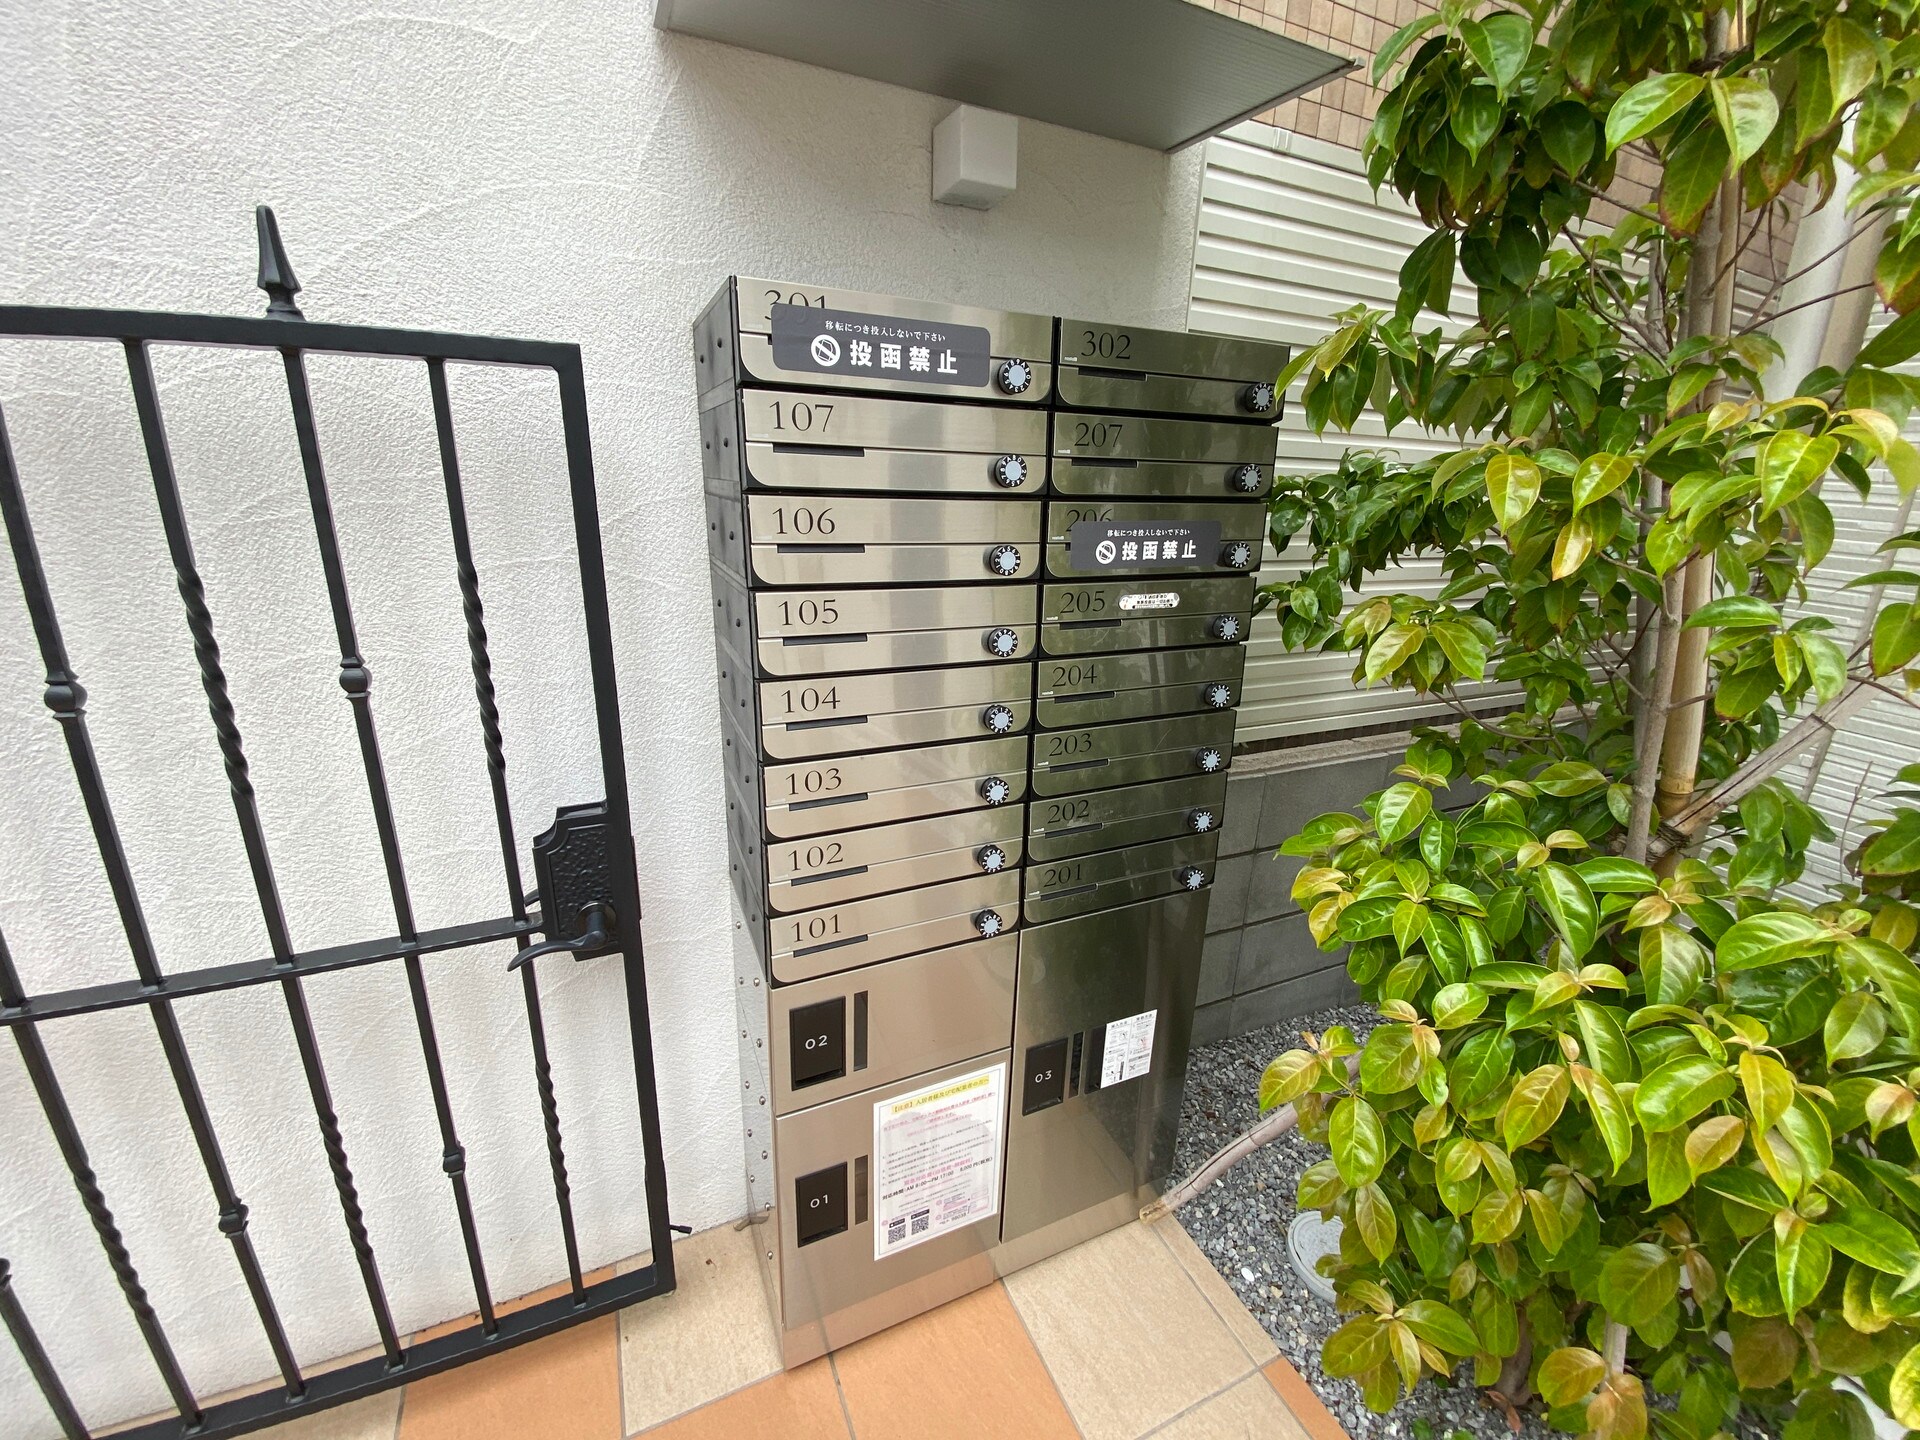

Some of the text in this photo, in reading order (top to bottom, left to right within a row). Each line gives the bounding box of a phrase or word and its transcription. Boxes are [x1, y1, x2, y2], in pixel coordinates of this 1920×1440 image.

[825, 320, 947, 342] 移転につき投入しないで下さい
[849, 339, 959, 375] 投函禁止
[1080, 330, 1132, 360] 302
[769, 401, 834, 432] 107
[1074, 422, 1123, 448] 207
[772, 507, 837, 535] 106
[1121, 539, 1197, 561] 投函禁止
[778, 598, 839, 626] 105
[1060, 590, 1106, 614] 205
[1052, 663, 1098, 688] 204
[781, 685, 841, 713] 104
[1048, 732, 1093, 757] 203
[785, 767, 842, 796] 103
[1047, 799, 1090, 825] 202
[788, 842, 844, 871] 102
[1043, 863, 1083, 888] 201
[790, 913, 842, 943] 101
[804, 1034, 828, 1050] 02
[1034, 1069, 1052, 1084] 03
[809, 1194, 829, 1208] 01
